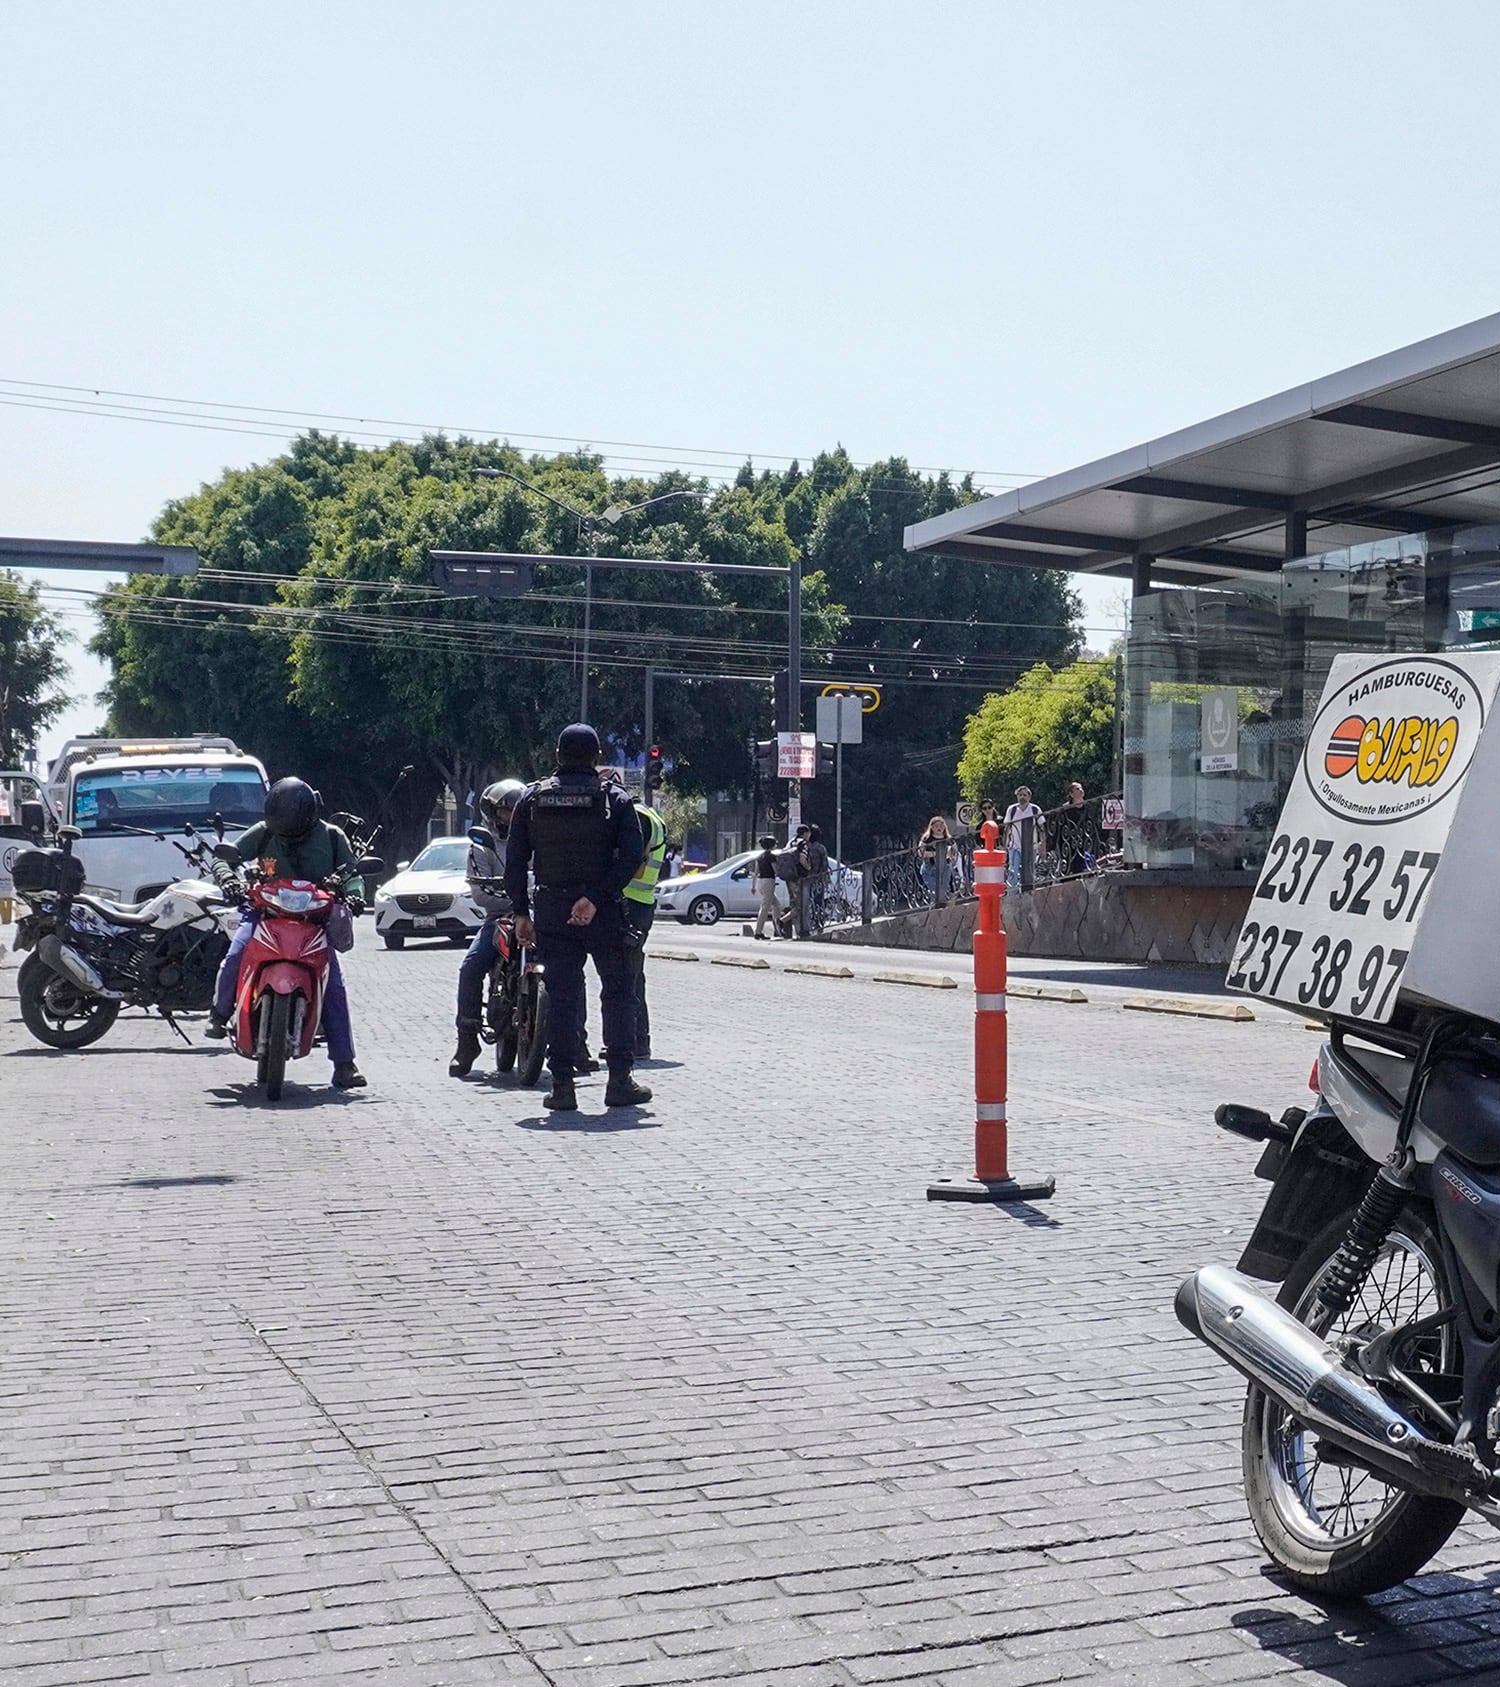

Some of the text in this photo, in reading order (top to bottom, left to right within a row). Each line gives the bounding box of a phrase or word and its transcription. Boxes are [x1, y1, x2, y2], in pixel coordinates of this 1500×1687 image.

[1348, 671, 1466, 711] HAMBURGUESAS
[1356, 714, 1460, 789] BUFALO
[121, 767, 224, 783] REYES
[1322, 783, 1377, 816] Orgullosamente
[1377, 796, 1426, 815] Mexicanas
[1255, 834, 1441, 923] 237 32 57
[1226, 921, 1410, 1020] 237 38 97
[1440, 1167, 1482, 1204] CARGO
